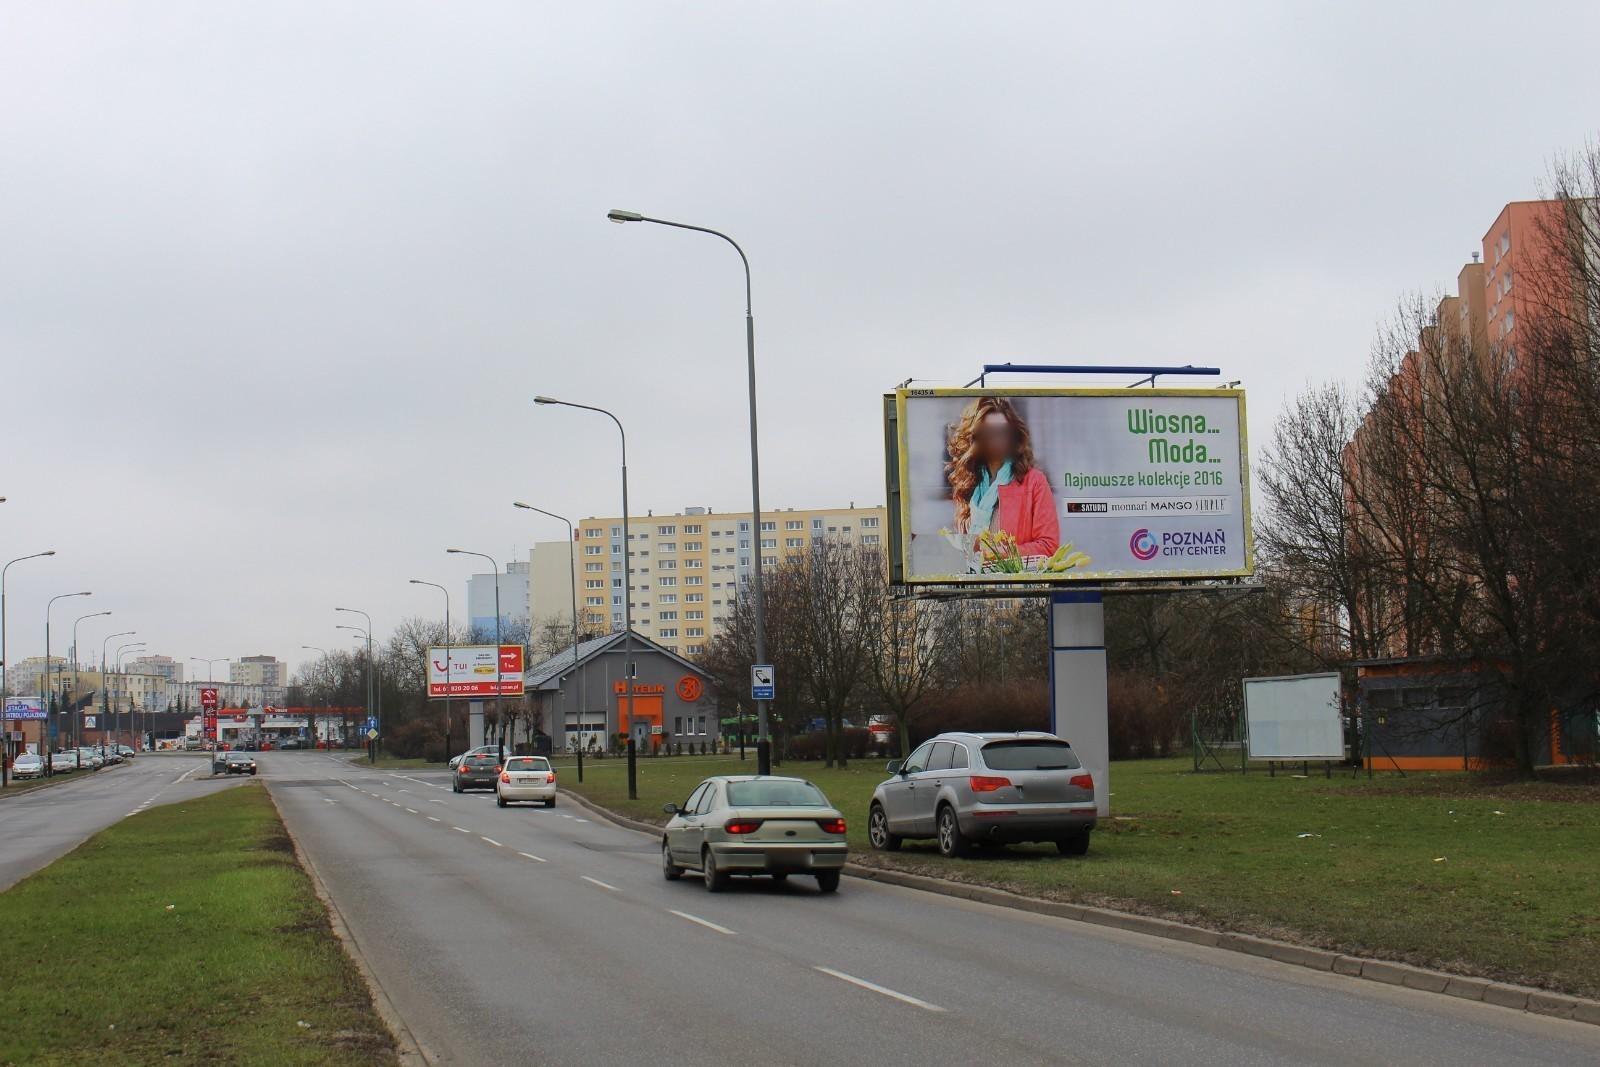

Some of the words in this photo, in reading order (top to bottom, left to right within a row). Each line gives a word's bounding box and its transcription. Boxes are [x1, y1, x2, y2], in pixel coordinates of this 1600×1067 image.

[1127, 408, 1220, 434] Wiosna...
[1149, 438, 1221, 463] Moda...
[1064, 472, 1135, 490] Najnowsze
[1138, 471, 1190, 489] kolekcje
[1194, 471, 1223, 486] 2016
[1081, 503, 1107, 512] SATURN
[1111, 501, 1148, 511] monnari
[1151, 501, 1193, 511] MANGO
[1162, 529, 1226, 545] POZNAŃ
[1162, 547, 1185, 556] CITY
[1187, 546, 1226, 556] CENTER
